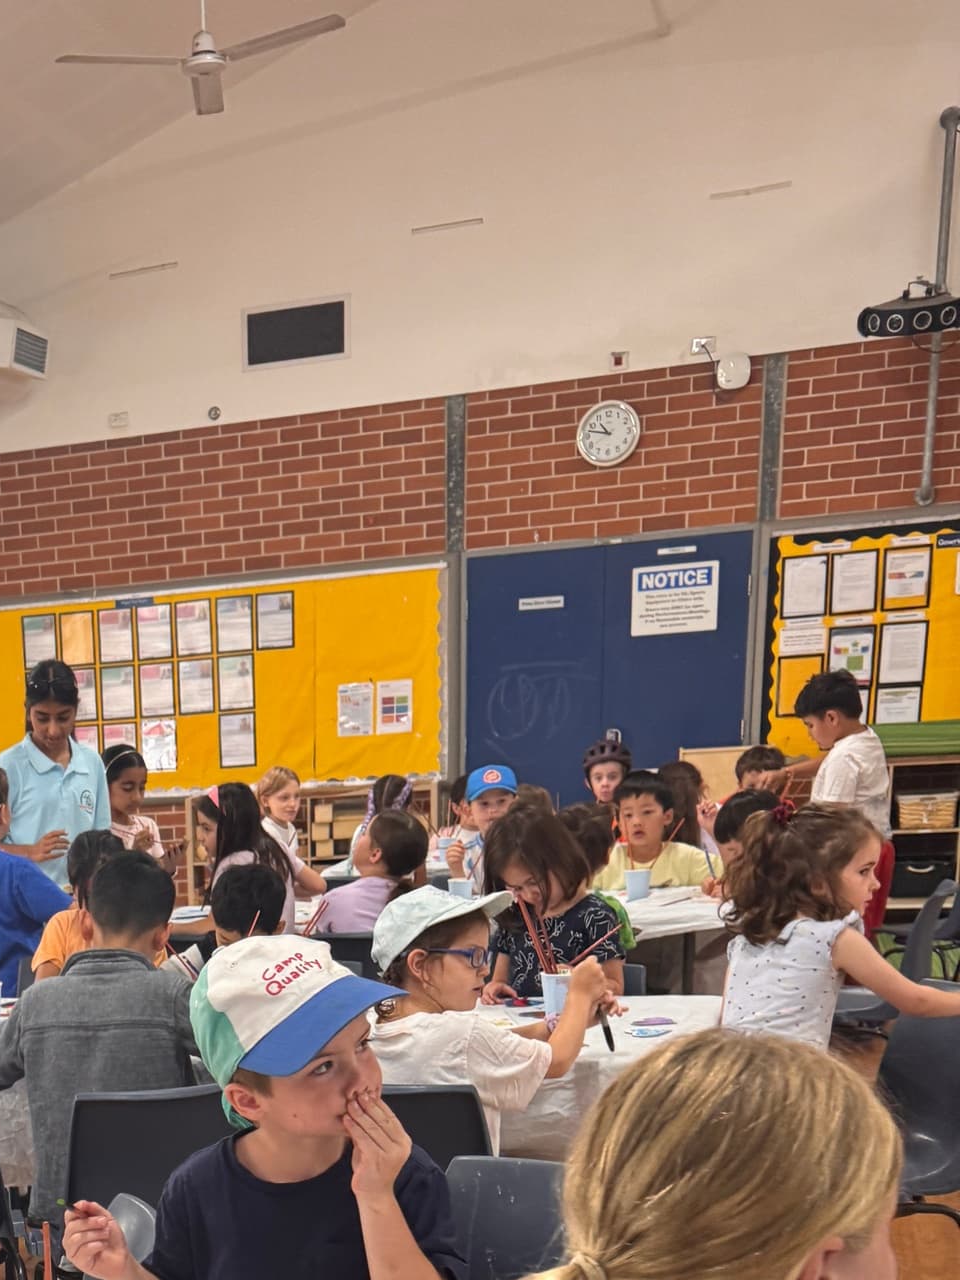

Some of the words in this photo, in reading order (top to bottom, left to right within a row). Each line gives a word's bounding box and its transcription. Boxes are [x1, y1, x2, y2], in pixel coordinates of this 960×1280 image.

[605, 410, 613, 418] 12
[589, 422, 596, 430] 10
[641, 569, 709, 590] NOTICE
[262, 952, 303, 981] Camp
[265, 959, 322, 996] Quality
